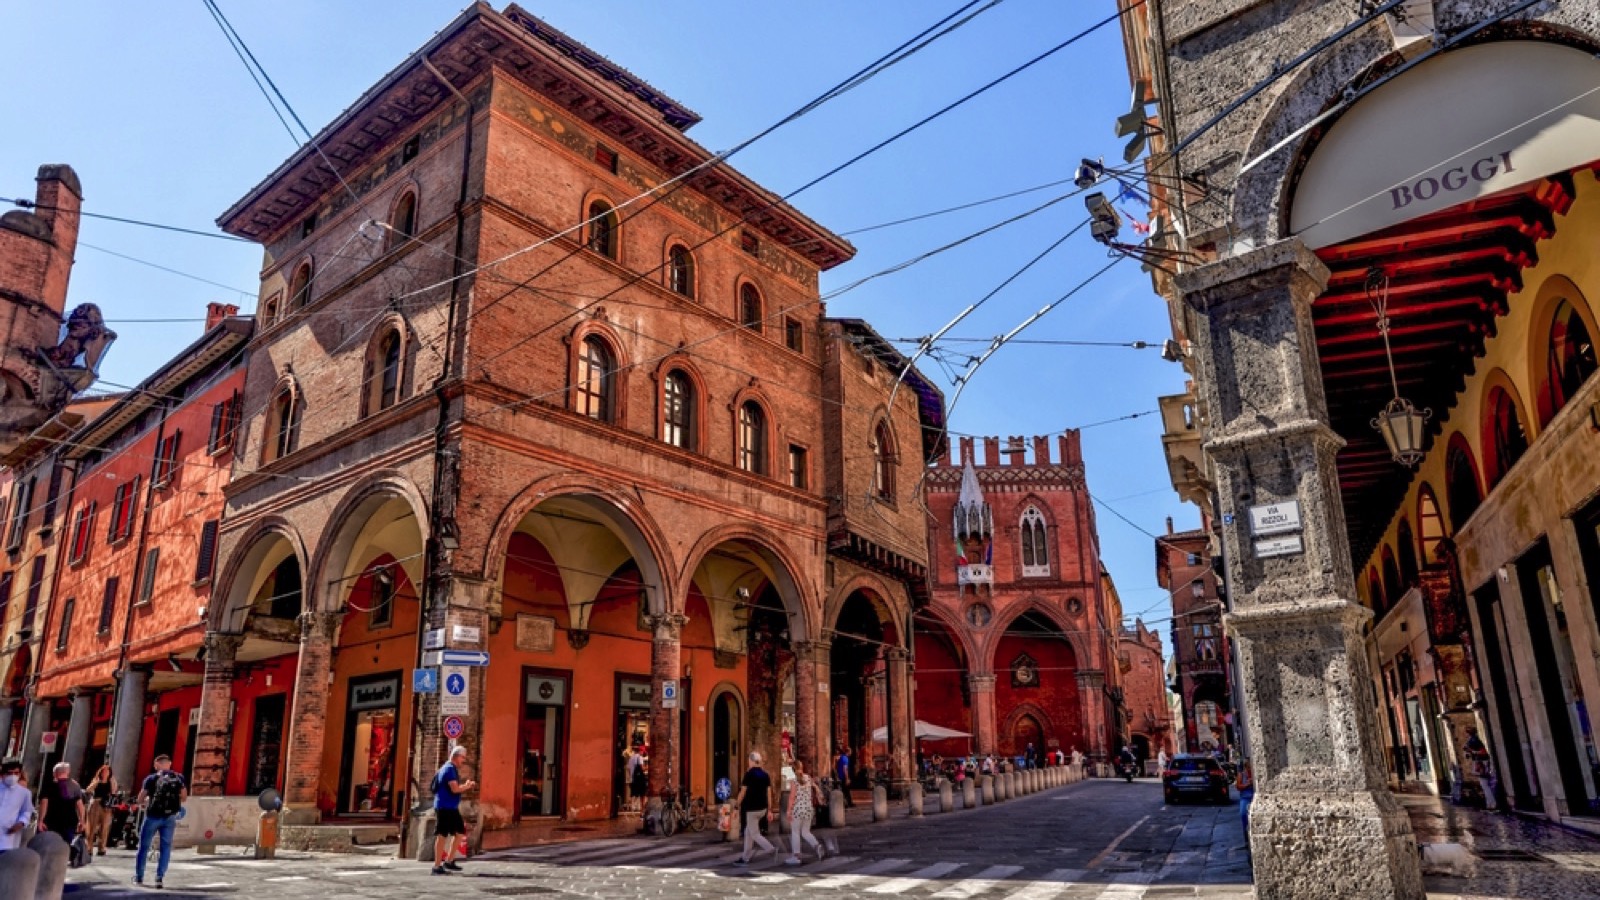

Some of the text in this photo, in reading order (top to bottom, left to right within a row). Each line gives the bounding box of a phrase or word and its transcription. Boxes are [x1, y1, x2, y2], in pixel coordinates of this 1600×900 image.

[1389, 150, 1517, 210] BOGGI
[1266, 506, 1279, 515] VIA
[1260, 513, 1288, 525] RIZZOLI
